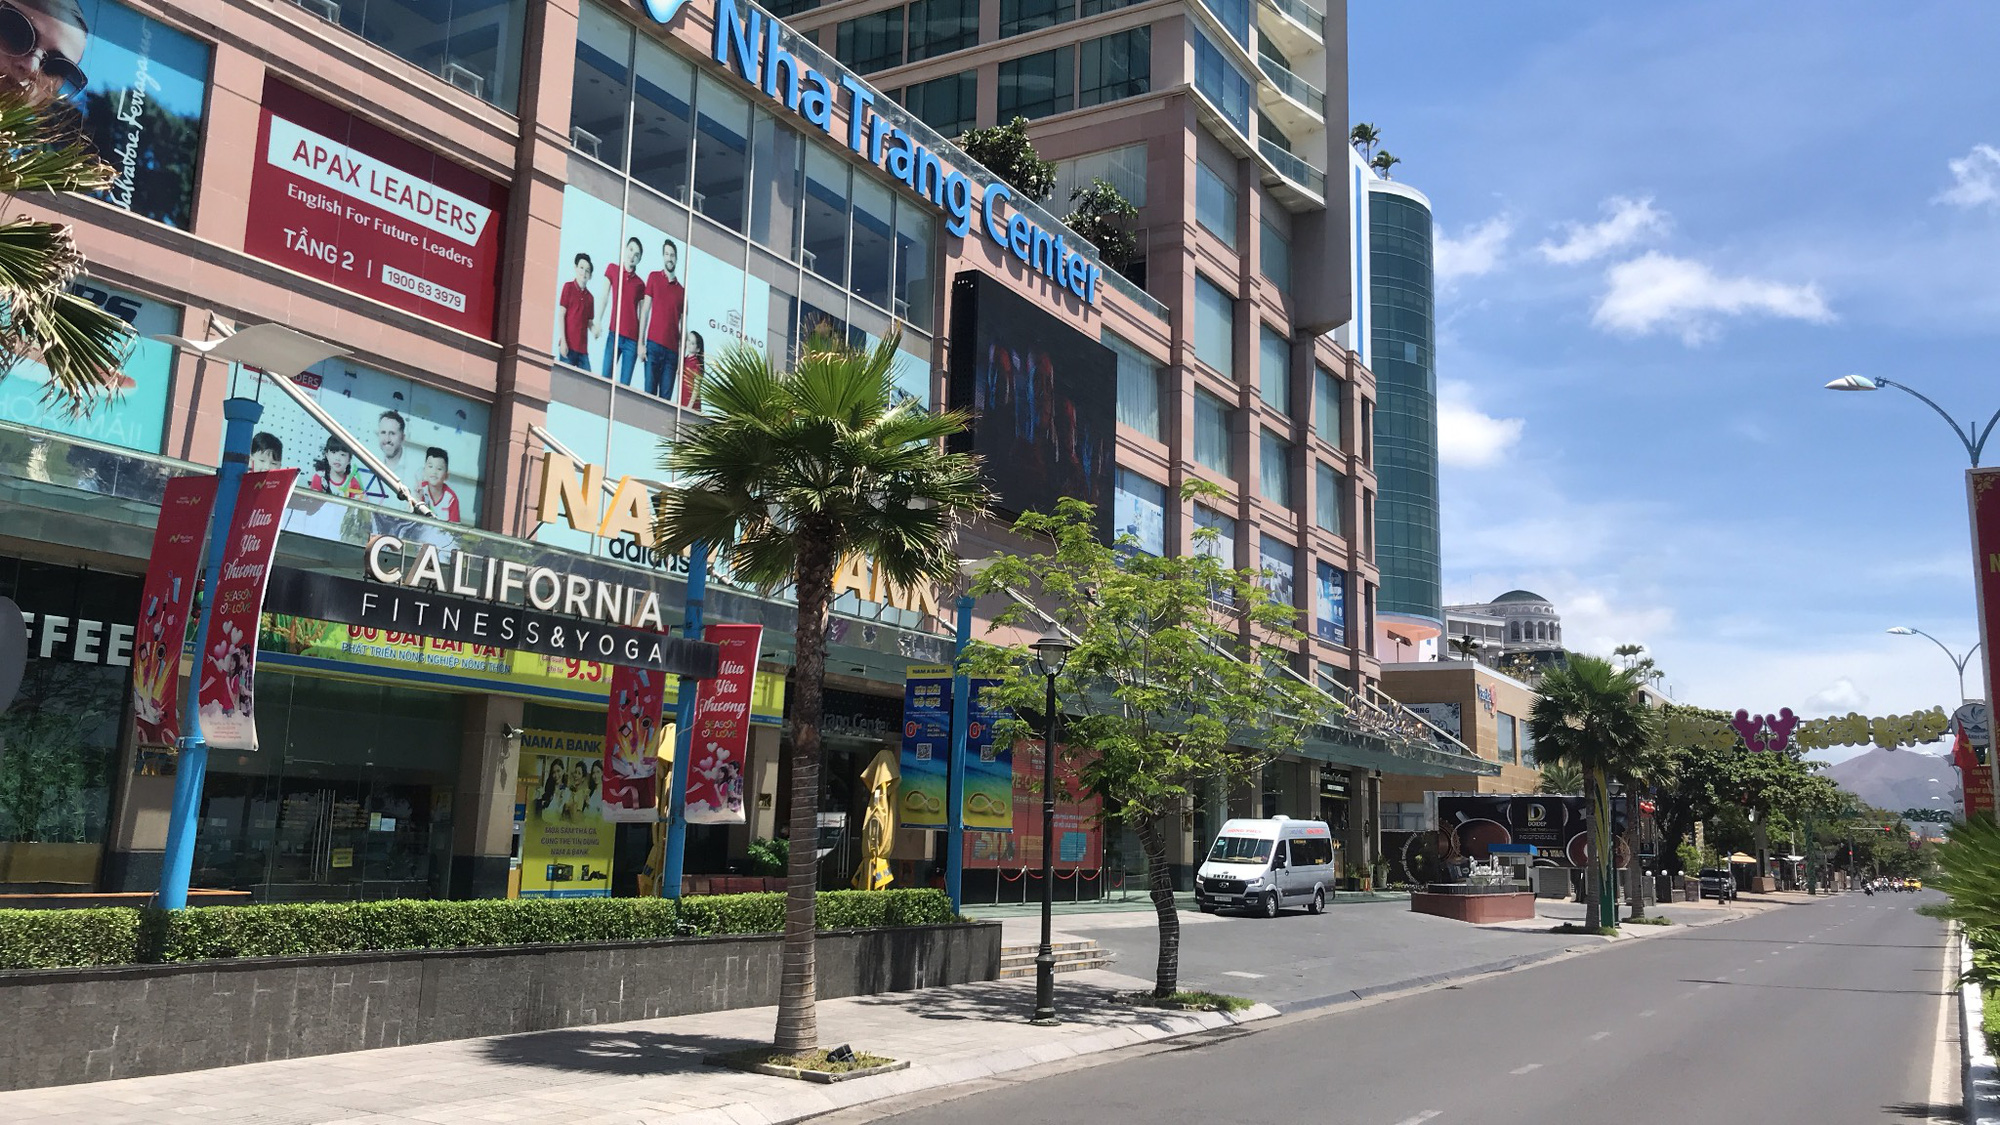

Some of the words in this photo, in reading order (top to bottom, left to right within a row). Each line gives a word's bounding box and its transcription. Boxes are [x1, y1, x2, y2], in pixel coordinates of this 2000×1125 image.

[713, 0, 833, 135] Nha
[839, 74, 973, 239] Trang
[981, 182, 1102, 306] Center
[292, 139, 362, 188] APAX
[369, 169, 478, 236] LEADERS
[287, 182, 342, 217] English
[346, 206, 371, 227] For
[373, 217, 419, 246] Future
[422, 237, 475, 269] Leaders
[283, 226, 338, 265] TẦNG
[341, 251, 355, 271] 2
[387, 270, 416, 291] 1900
[416, 278, 433, 296] 63
[433, 287, 462, 308] 3979
[708, 318, 764, 349] GIORDANO
[242, 508, 272, 530] Mùa
[240, 534, 262, 557] Yêu
[223, 558, 265, 587] Thương
[365, 534, 665, 632] CALIFORNIA
[224, 589, 253, 602] SEASON
[341, 641, 368, 656] PHÁT
[397, 648, 425, 664] NÔNG
[426, 652, 461, 669] NGHIỆP
[461, 657, 486, 672] NÔNG
[487, 660, 511, 674] THÔN
[718, 660, 745, 675] Mùa
[714, 679, 738, 696] Yêu
[698, 695, 746, 719] Thương
[1409, 706, 1430, 714] RANG
[705, 719, 737, 729] SEASON
[715, 728, 738, 738] LOVE
[822, 711, 850, 731] rang
[853, 712, 891, 734] Center
[521, 734, 552, 749] NAM
[554, 738, 564, 750] A
[566, 738, 602, 753] BANK
